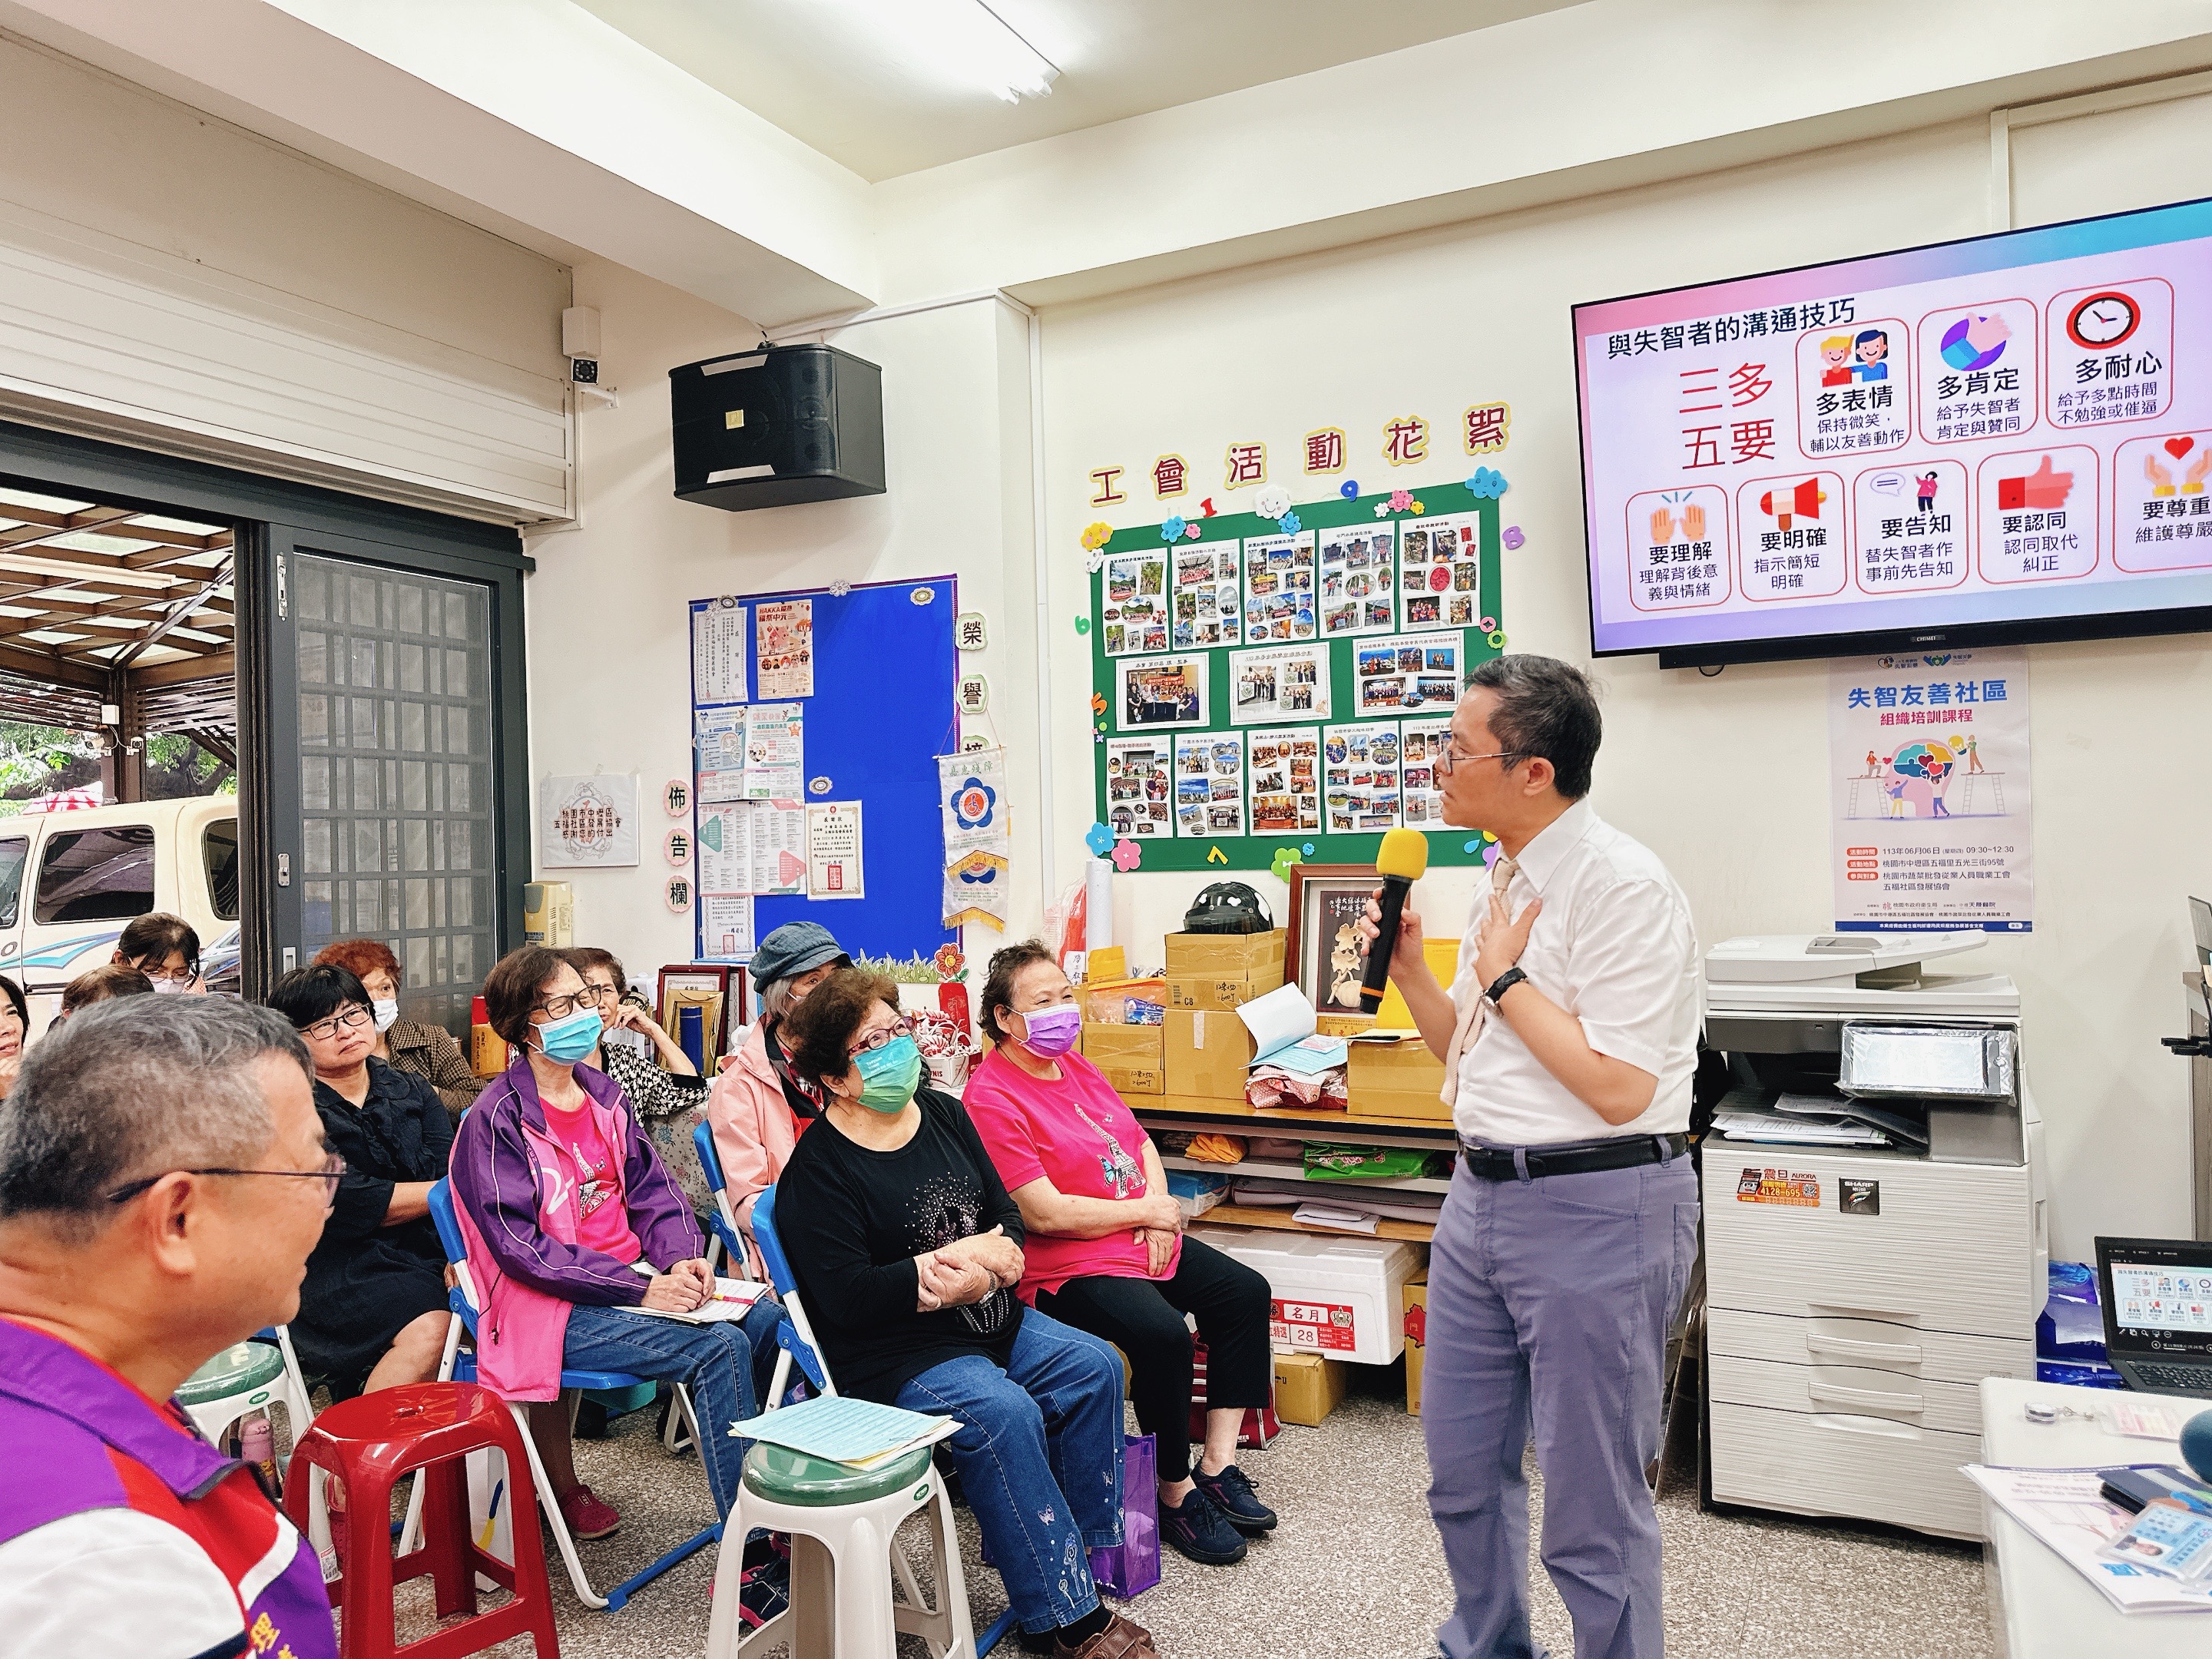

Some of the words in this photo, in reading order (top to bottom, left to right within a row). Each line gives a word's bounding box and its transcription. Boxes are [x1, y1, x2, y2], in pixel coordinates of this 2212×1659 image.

[1608, 297, 1855, 359] 與失智者的溝通技巧
[2075, 351, 2162, 384] 多耐心
[1678, 363, 1773, 414] 三多
[1937, 368, 2019, 400] 多肯定
[2058, 382, 2157, 407] 給予多點時間
[1816, 386, 1892, 416] 多表情
[1936, 397, 2021, 421] 給予失智者
[2058, 400, 2157, 424] 不勉強或催逼
[1936, 416, 2021, 440] 肯定與贊同
[1682, 419, 1775, 469] 五要
[1810, 429, 1905, 452] 輔以友善動作
[1092, 406, 1505, 503] 工會活動花絮
[2143, 497, 2211, 521] 要尊重
[1881, 513, 1952, 538] 要告知
[2002, 512, 2066, 534] 要認同
[2135, 520, 2212, 545] 維護尊嚴
[1760, 528, 1827, 551] 要明確
[1865, 541, 1953, 561] 替失智者作
[2004, 532, 2078, 555] 認同取代
[1650, 541, 1713, 565] 要理解
[1754, 553, 1820, 574] 指示簡短
[2023, 555, 2058, 573] 糾正
[1639, 563, 1718, 584] 理解背後意
[1770, 575, 1804, 590] 明確
[1866, 561, 1953, 581] 事前先告知
[1648, 582, 1710, 601] 義與情緒
[1847, 679, 2008, 710] 失智友善社區
[1879, 709, 1974, 727] 組織培訓課程
[949, 760, 993, 777] 嘉惠殘障
[555, 817, 622, 829] 五福社區發展協會
[562, 807, 613, 819] 桃園市中壢區
[563, 829, 613, 839] 感謝您的付出
[669, 787, 688, 905] 佈告欄
[1883, 870, 2011, 880] 桃園市蔬菜批發從業人員職業工會
[1883, 882, 1950, 891] 五福社區發展協會
[1764, 1168, 1788, 1180] 震旦
[1760, 1187, 1800, 1198] 4128-695
[1292, 1307, 1319, 1322] 名月
[1297, 1330, 1313, 1342] 28
